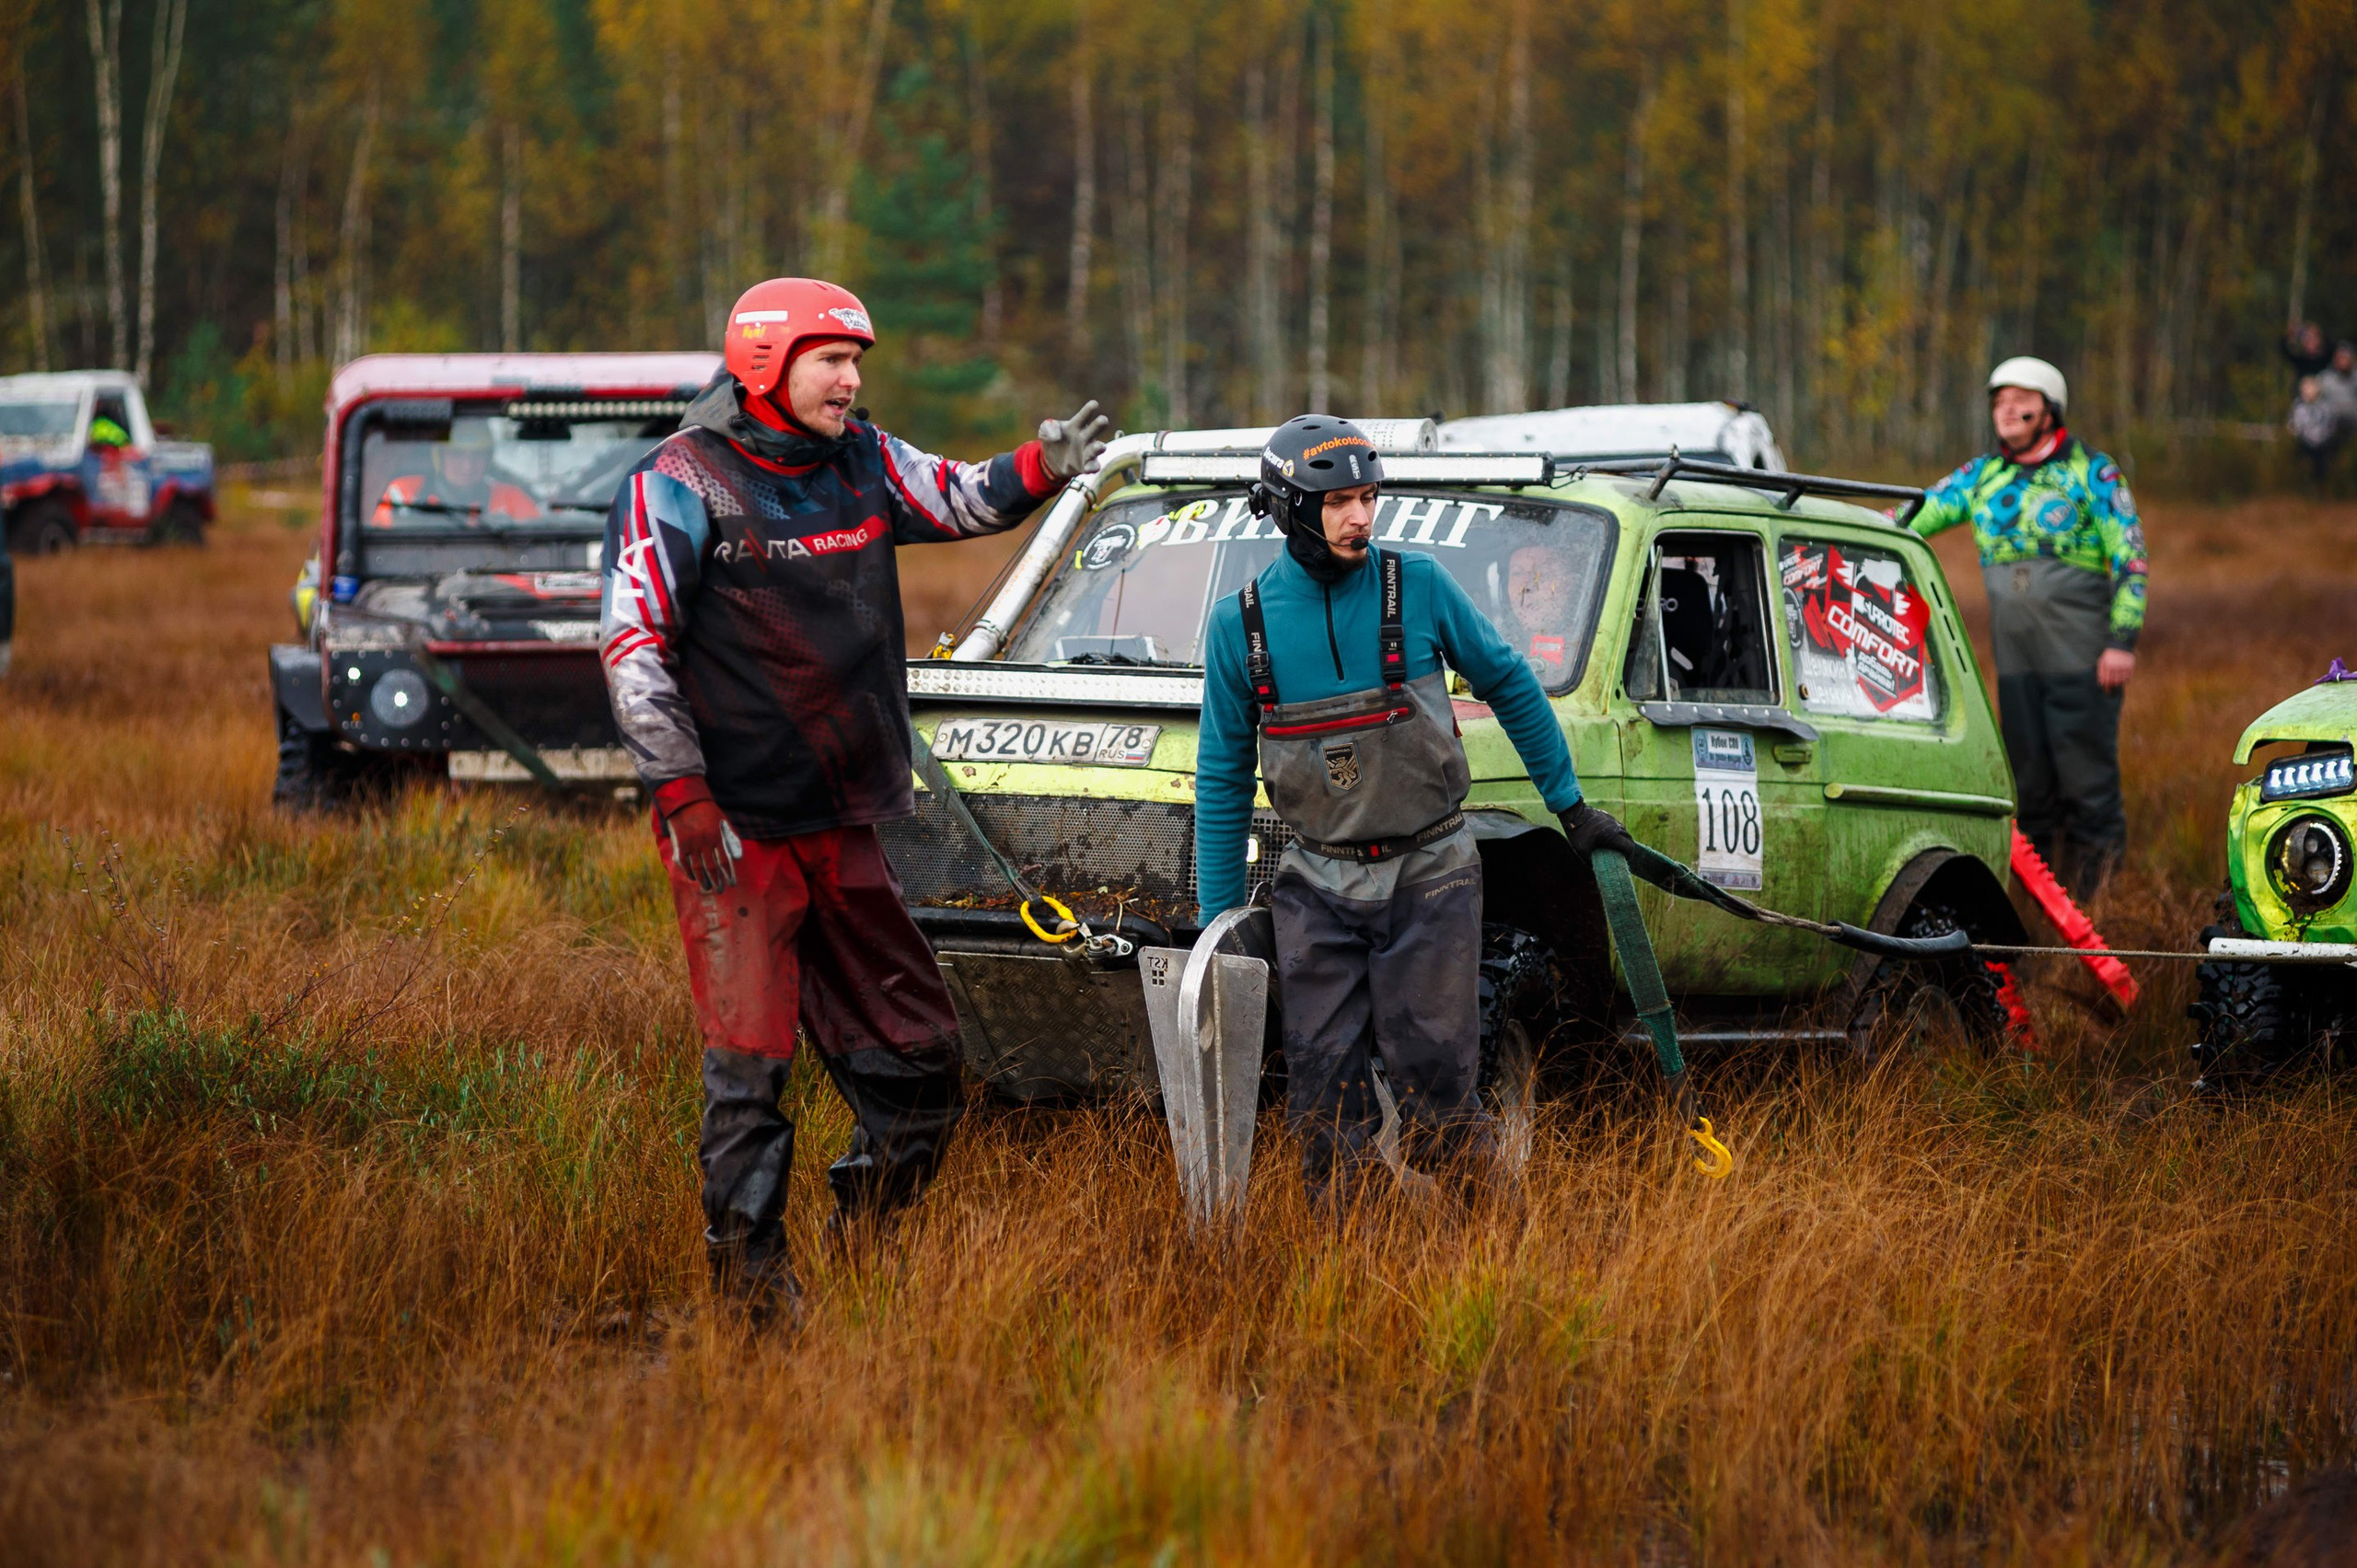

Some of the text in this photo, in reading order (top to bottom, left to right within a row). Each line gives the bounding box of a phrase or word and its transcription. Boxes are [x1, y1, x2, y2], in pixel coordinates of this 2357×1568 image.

[813, 528, 868, 552] RACING
[1160, 495, 1504, 548] ВИНГ
[1387, 559, 1397, 618] FINNTRAIL
[1828, 605, 1920, 678] COMFORT
[946, 723, 1144, 757] М320КВ 78
[1098, 749, 1125, 759] RUS
[1702, 788, 1759, 854] 108
[1424, 877, 1476, 900] FINNTRAIL
